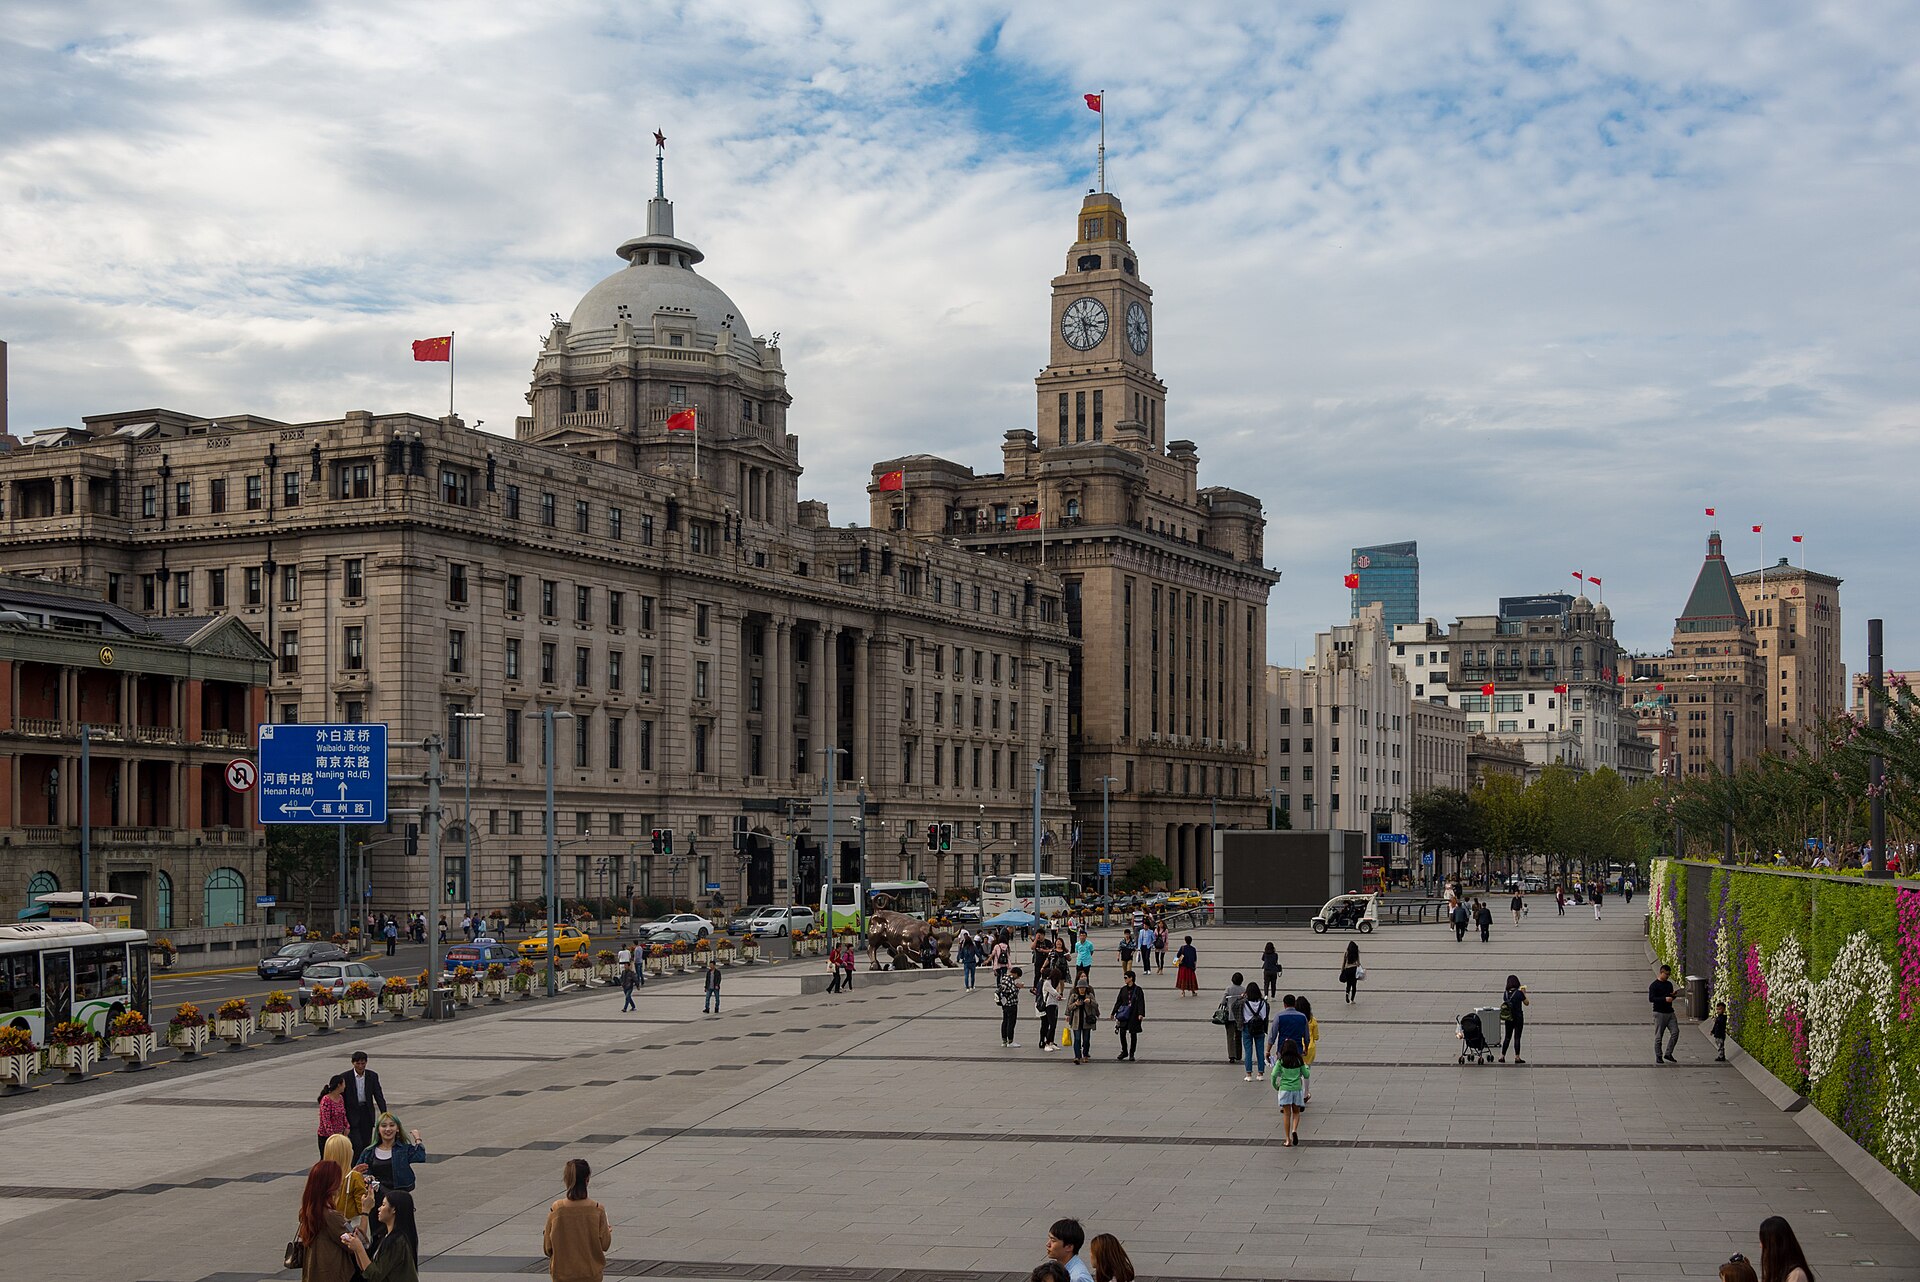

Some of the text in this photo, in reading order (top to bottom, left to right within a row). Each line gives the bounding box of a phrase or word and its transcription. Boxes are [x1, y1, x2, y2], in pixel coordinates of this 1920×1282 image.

[316, 730, 370, 742] 外白渡桥
[316, 744, 370, 753] Waibaidu Bridge
[316, 756, 370, 768] 南京东路
[263, 772, 314, 785] 河南中路
[316, 771, 370, 780] Nanjing Rd.(E)
[290, 787, 314, 797] Rd.(M)
[322, 804, 364, 813] 福州路
